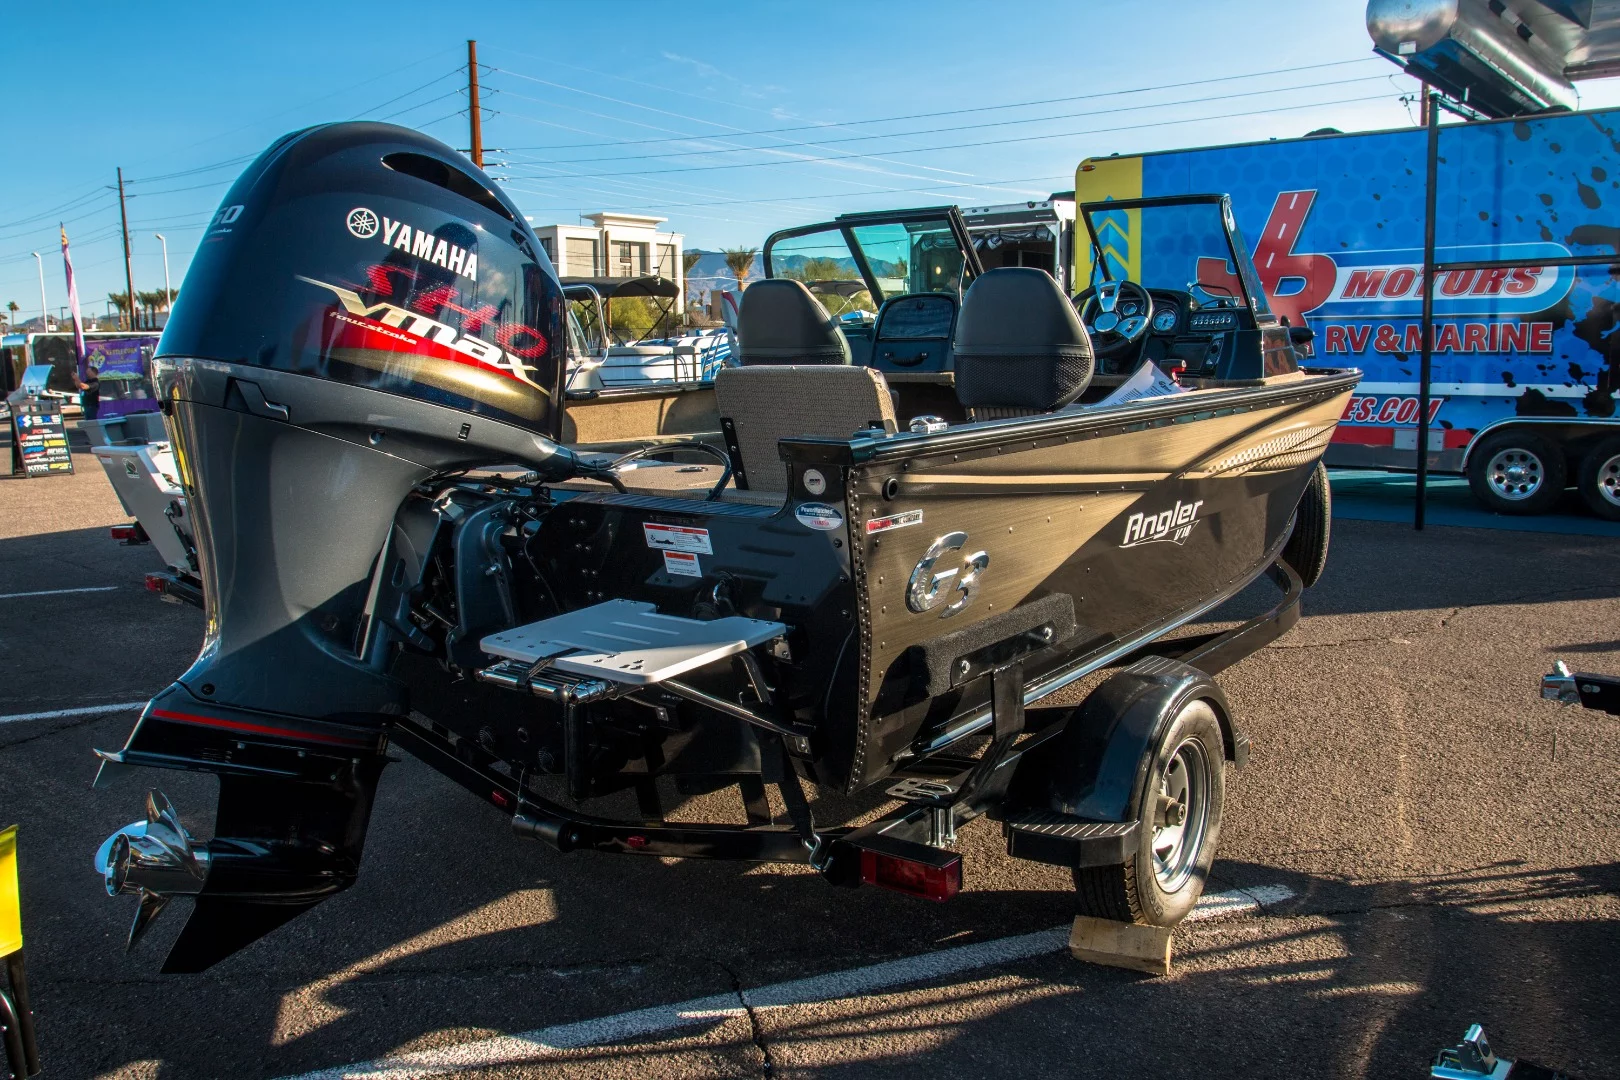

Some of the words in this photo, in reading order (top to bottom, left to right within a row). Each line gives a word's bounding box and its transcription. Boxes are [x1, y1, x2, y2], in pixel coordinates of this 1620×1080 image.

[382, 216, 478, 282] YAMAHA
[1340, 265, 1545, 300] MOTORS
[1123, 500, 1203, 544] Angler
[905, 531, 990, 619] G3
